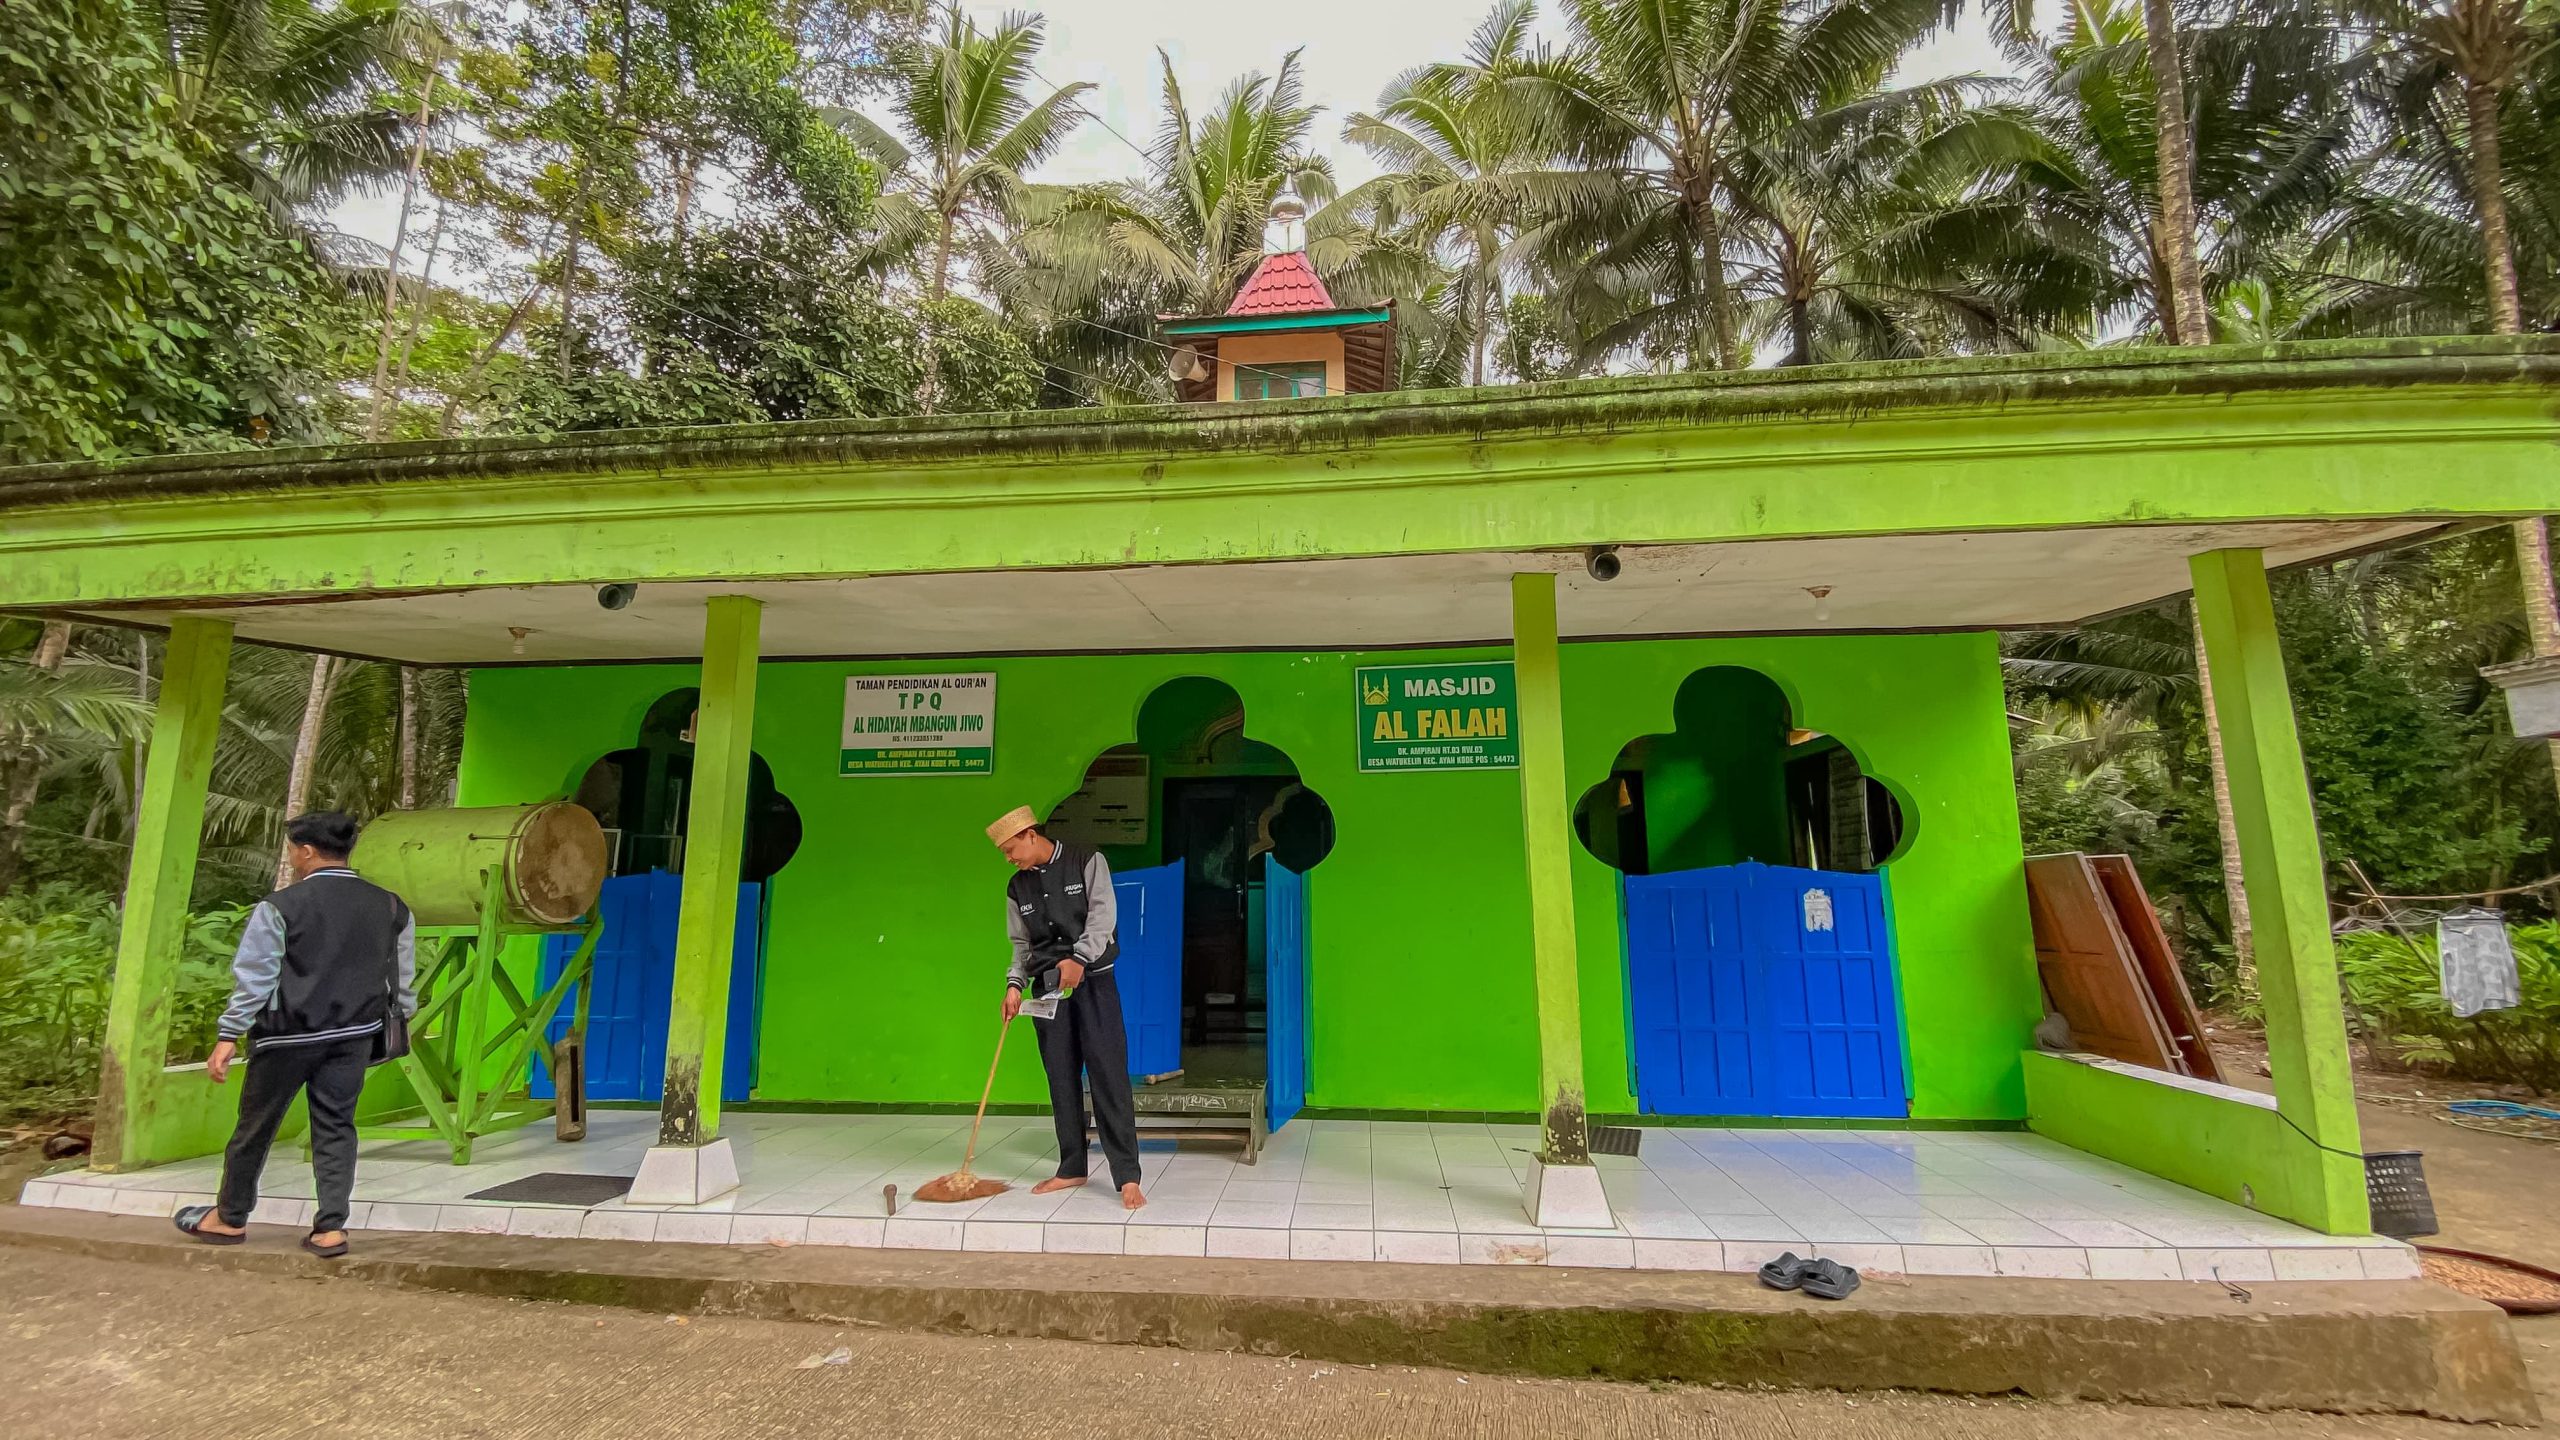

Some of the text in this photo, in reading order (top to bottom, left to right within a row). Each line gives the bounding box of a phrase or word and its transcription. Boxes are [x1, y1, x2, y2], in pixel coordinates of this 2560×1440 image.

[856, 677, 987, 690] TAMAN PENDIDIKAN AL QUR'AN
[1404, 677, 1496, 698] MASJID
[853, 714, 984, 734] AL HIDAYAH MBANGUN JIWO
[1373, 708, 1507, 740] AL FALAH
[1410, 746, 1441, 755] AMPIRAN
[1442, 746, 1460, 754] RT.03
[1367, 758, 1385, 766] DESA
[1385, 757, 1422, 766] WATUKELIR
[1422, 756, 1438, 765] KEC.
[1438, 756, 1456, 765] AYAH
[1456, 755, 1474, 764] KODE
[1475, 755, 1489, 764] POS
[1493, 755, 1515, 763] 54473
